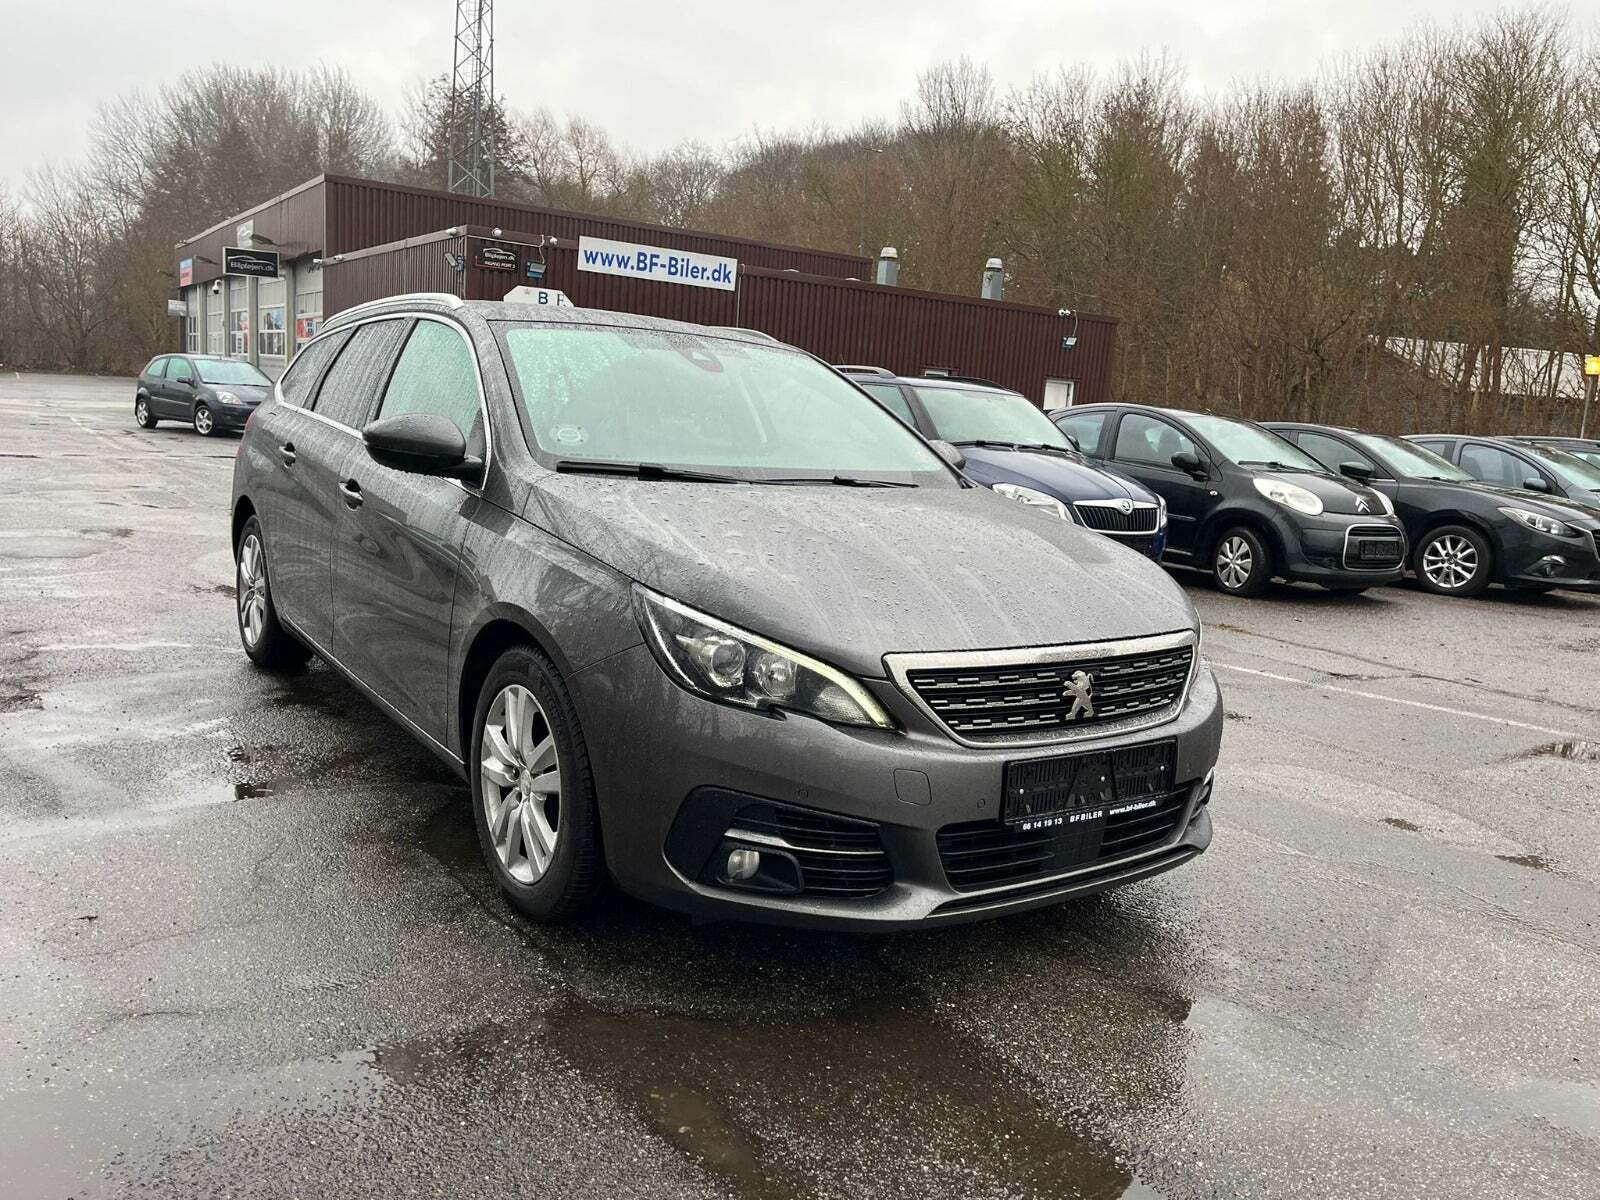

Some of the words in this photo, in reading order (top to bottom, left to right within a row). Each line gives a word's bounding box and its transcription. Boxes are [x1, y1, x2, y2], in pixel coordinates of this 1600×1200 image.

[583, 249, 732, 284] www.BF-Biler.dk
[1033, 820, 1042, 829] 14
[1044, 819, 1053, 827] 19
[1054, 817, 1063, 825] 13
